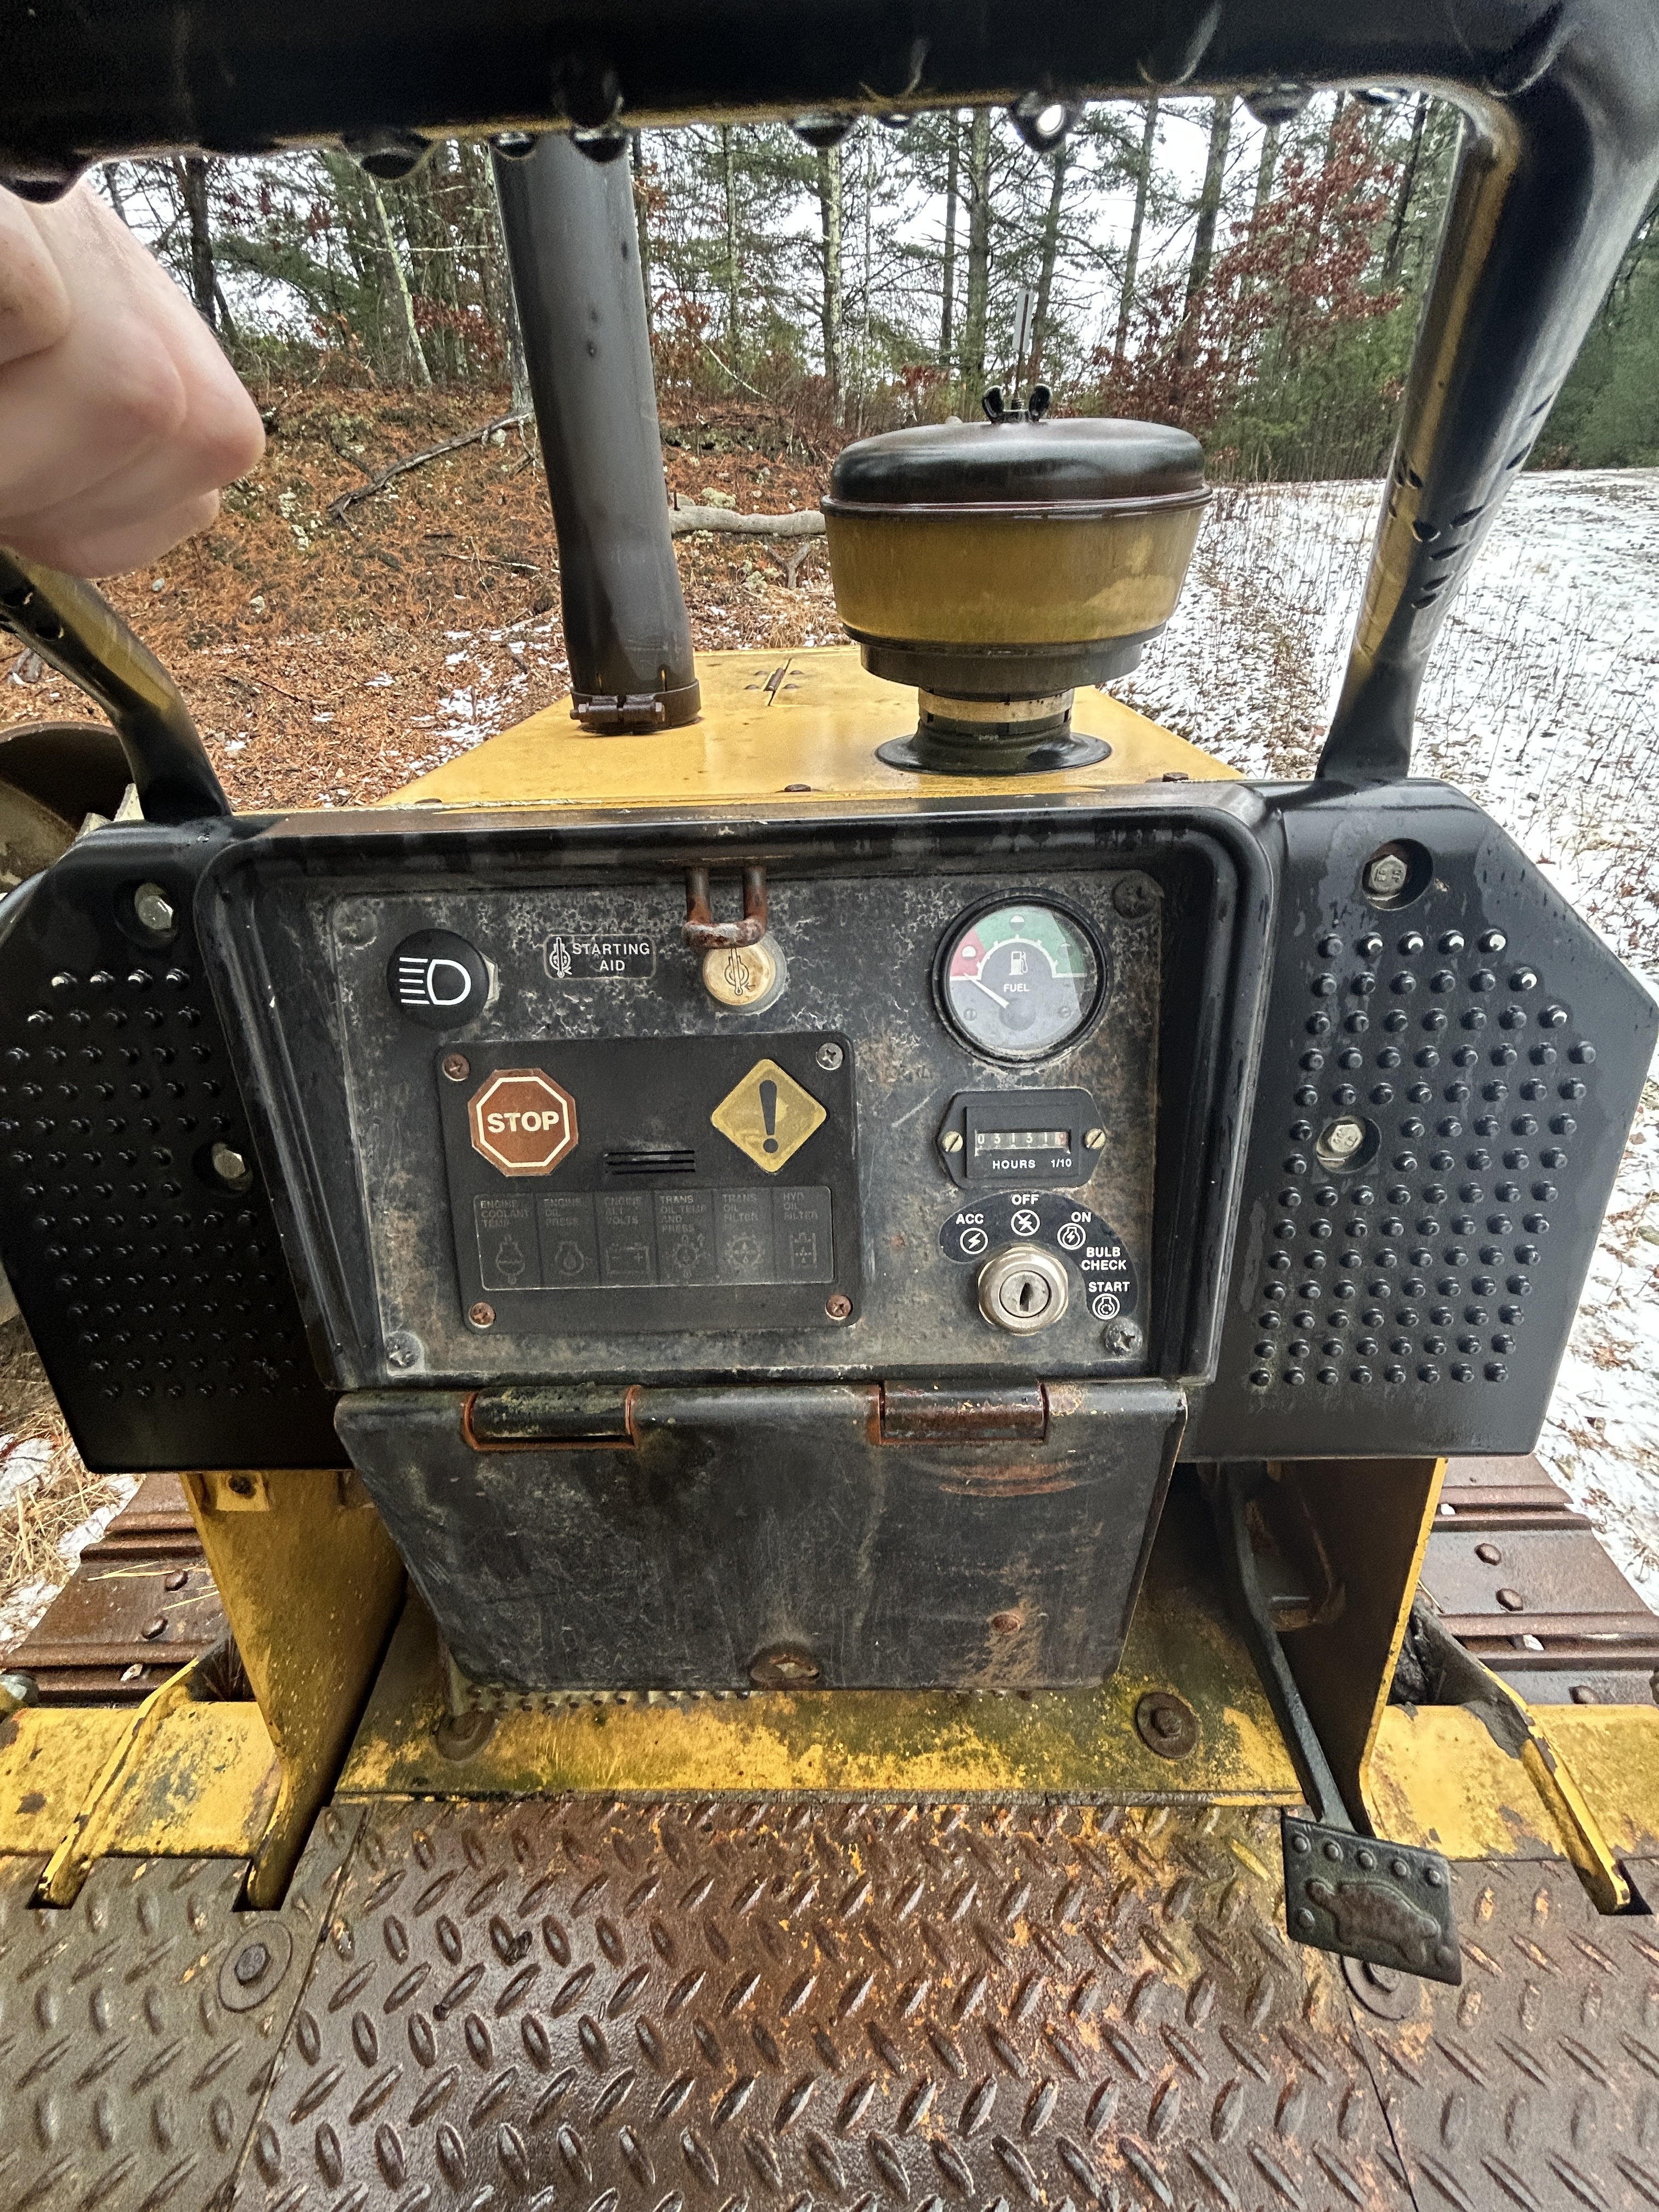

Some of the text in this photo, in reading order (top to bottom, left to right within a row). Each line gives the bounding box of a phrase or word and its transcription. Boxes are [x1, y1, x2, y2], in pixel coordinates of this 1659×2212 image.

[572, 943, 650, 955] STARTING
[600, 960, 625, 971] AID
[1003, 983, 1030, 992] FUEL
[487, 1111, 560, 1133] STOP
[992, 1158, 1072, 1169] HOURS 1/10
[660, 1195, 694, 1204] TRANS
[723, 1193, 757, 1203] TRANS
[1012, 1194, 1039, 1205] OFF
[661, 1205, 675, 1214] OIL
[723, 1204, 739, 1212] OIL
[783, 1202, 797, 1211] OIL
[956, 1214, 984, 1224] ACC
[1071, 1211, 1092, 1223] ON
[1086, 1246, 1121, 1257] BULB
[1081, 1260, 1127, 1271] CHECK
[1088, 1282, 1130, 1293] START
